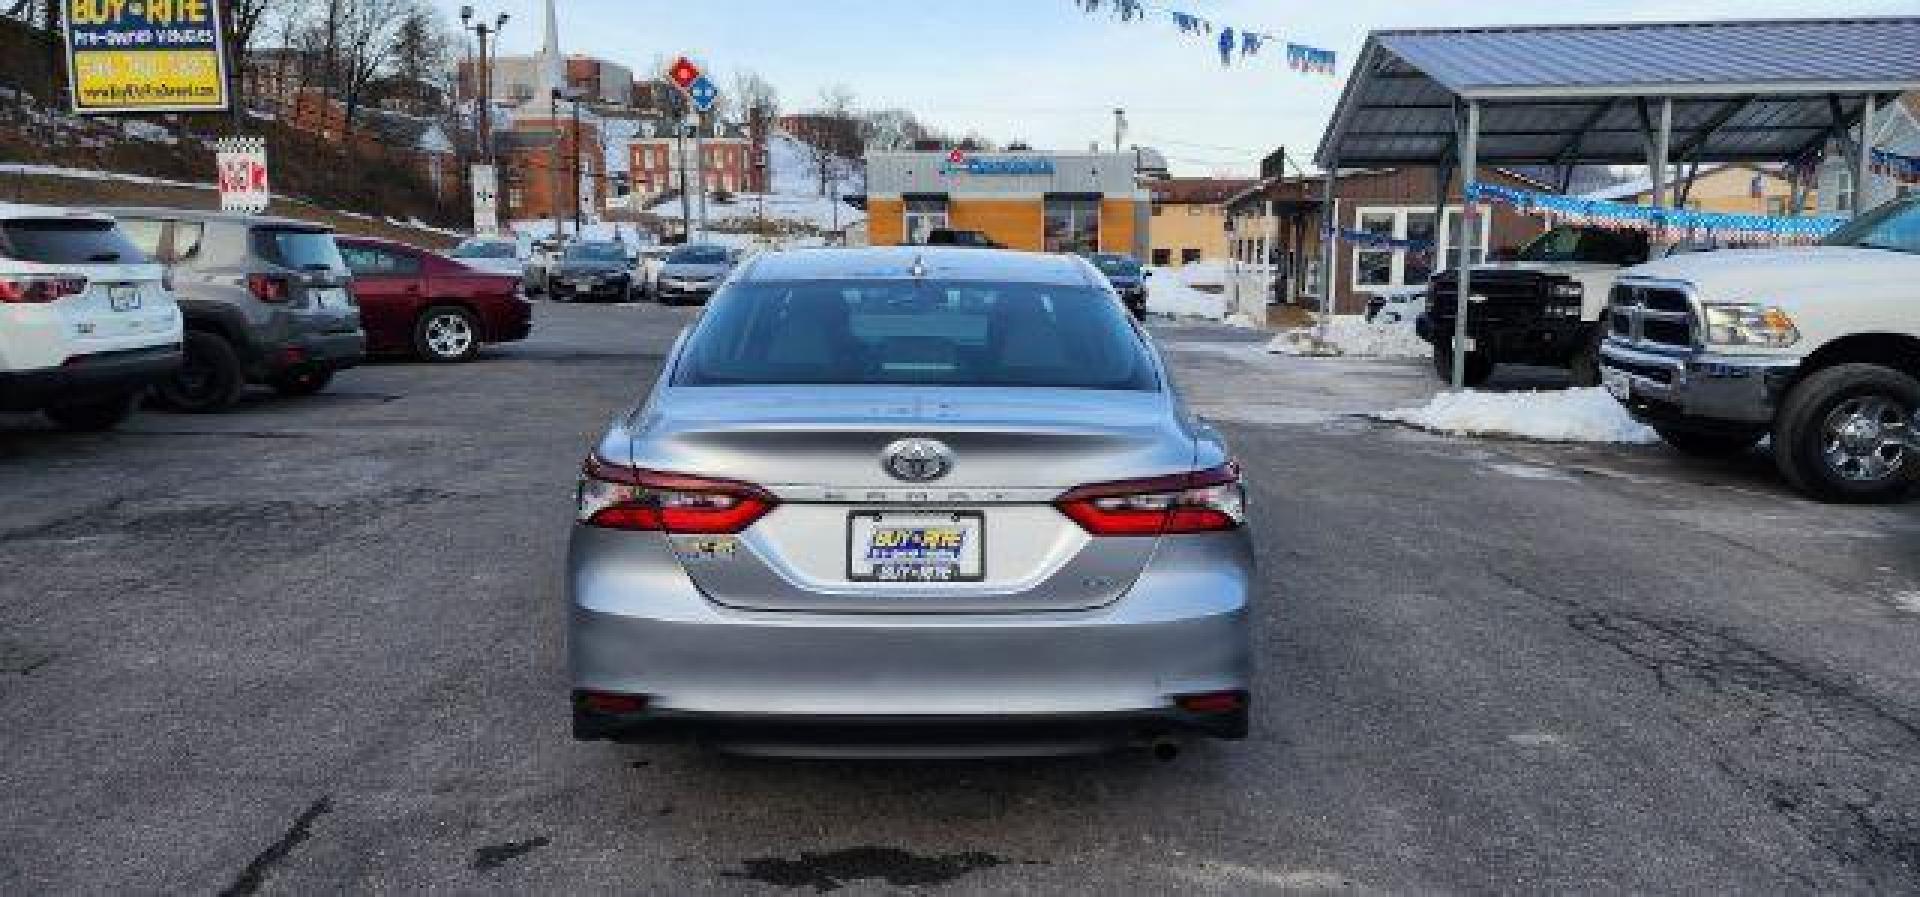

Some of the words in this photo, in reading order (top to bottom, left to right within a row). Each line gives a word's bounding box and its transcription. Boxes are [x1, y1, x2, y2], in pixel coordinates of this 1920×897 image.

[71, 0, 125, 24] BUY
[146, 0, 208, 24] RITE
[874, 527, 912, 547] BUY
[922, 526, 961, 548] RITE
